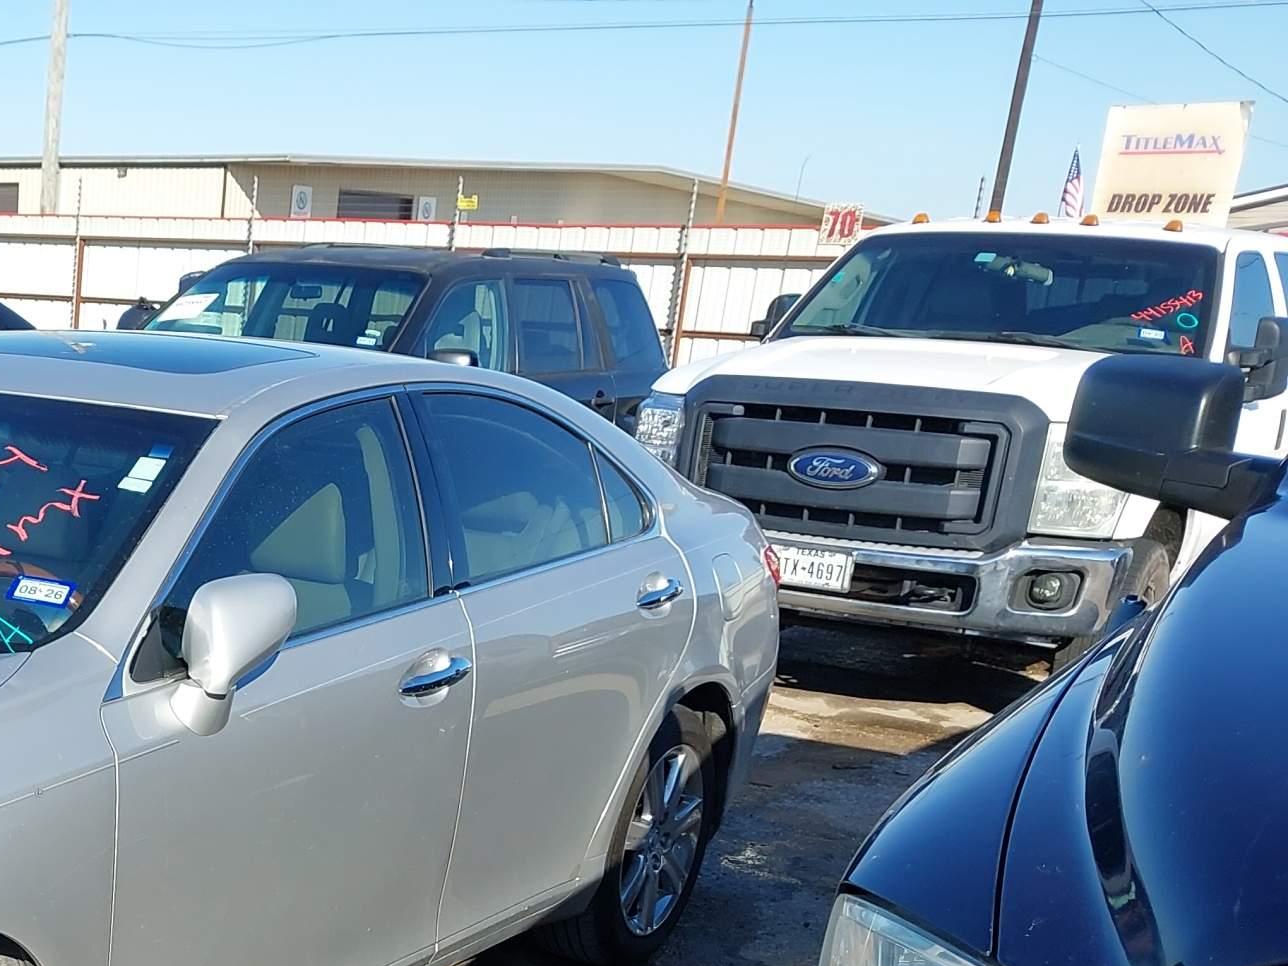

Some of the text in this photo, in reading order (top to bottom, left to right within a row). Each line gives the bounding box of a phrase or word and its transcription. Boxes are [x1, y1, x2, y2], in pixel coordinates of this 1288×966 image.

[1106, 193, 1215, 213] DROP ZONE
[827, 210, 856, 238] 70
[1179, 335, 1194, 355] A
[806, 456, 855, 480] Ford
[796, 548, 825, 558] TEXAS
[778, 557, 843, 582] TX-4697
[19, 584, 64, 600] 08 26
